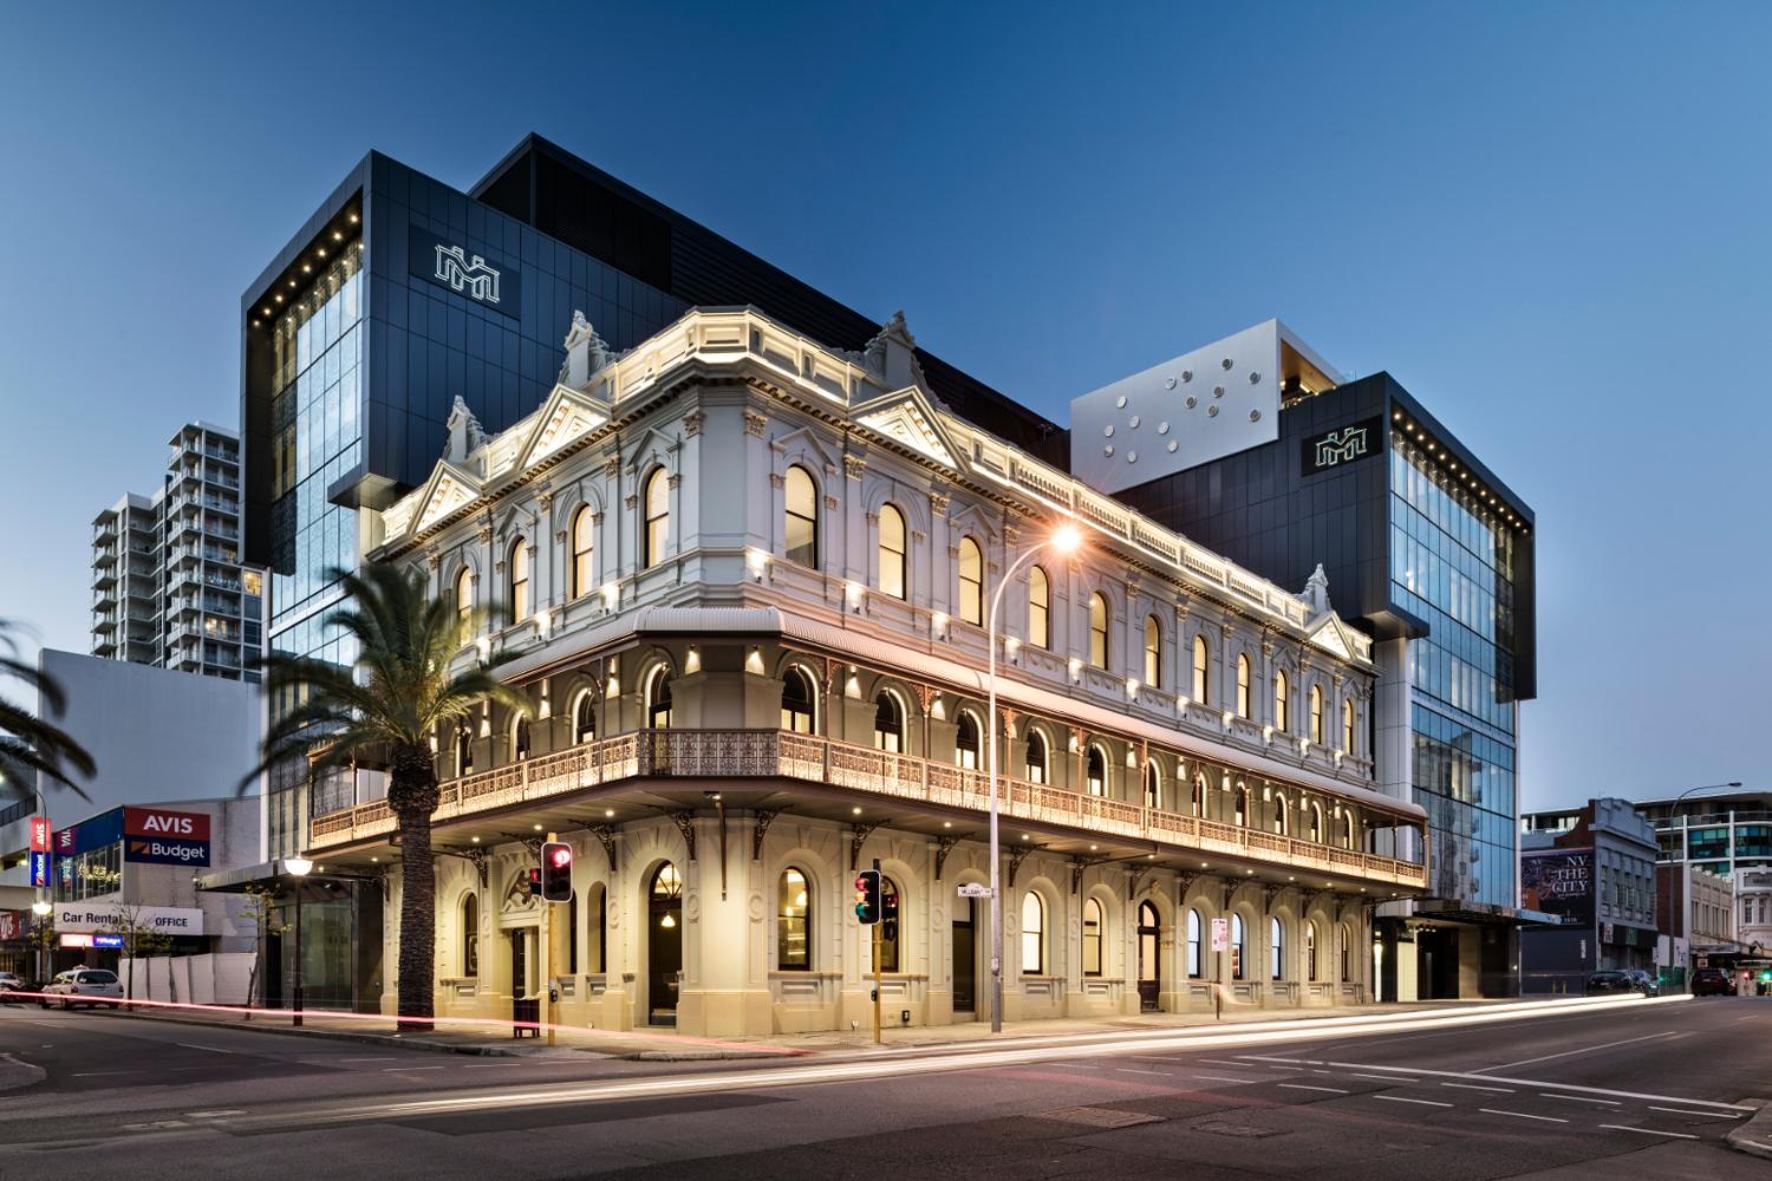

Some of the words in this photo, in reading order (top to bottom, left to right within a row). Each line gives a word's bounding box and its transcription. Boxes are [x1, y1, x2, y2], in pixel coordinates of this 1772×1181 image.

[143, 815, 193, 834] AVIS
[152, 843, 205, 861] Budget
[1567, 856, 1588, 867] NV
[1552, 867, 1589, 881] THE
[1551, 880, 1588, 894] CITY
[62, 912, 83, 923] Car
[155, 917, 188, 927] OFFICE
